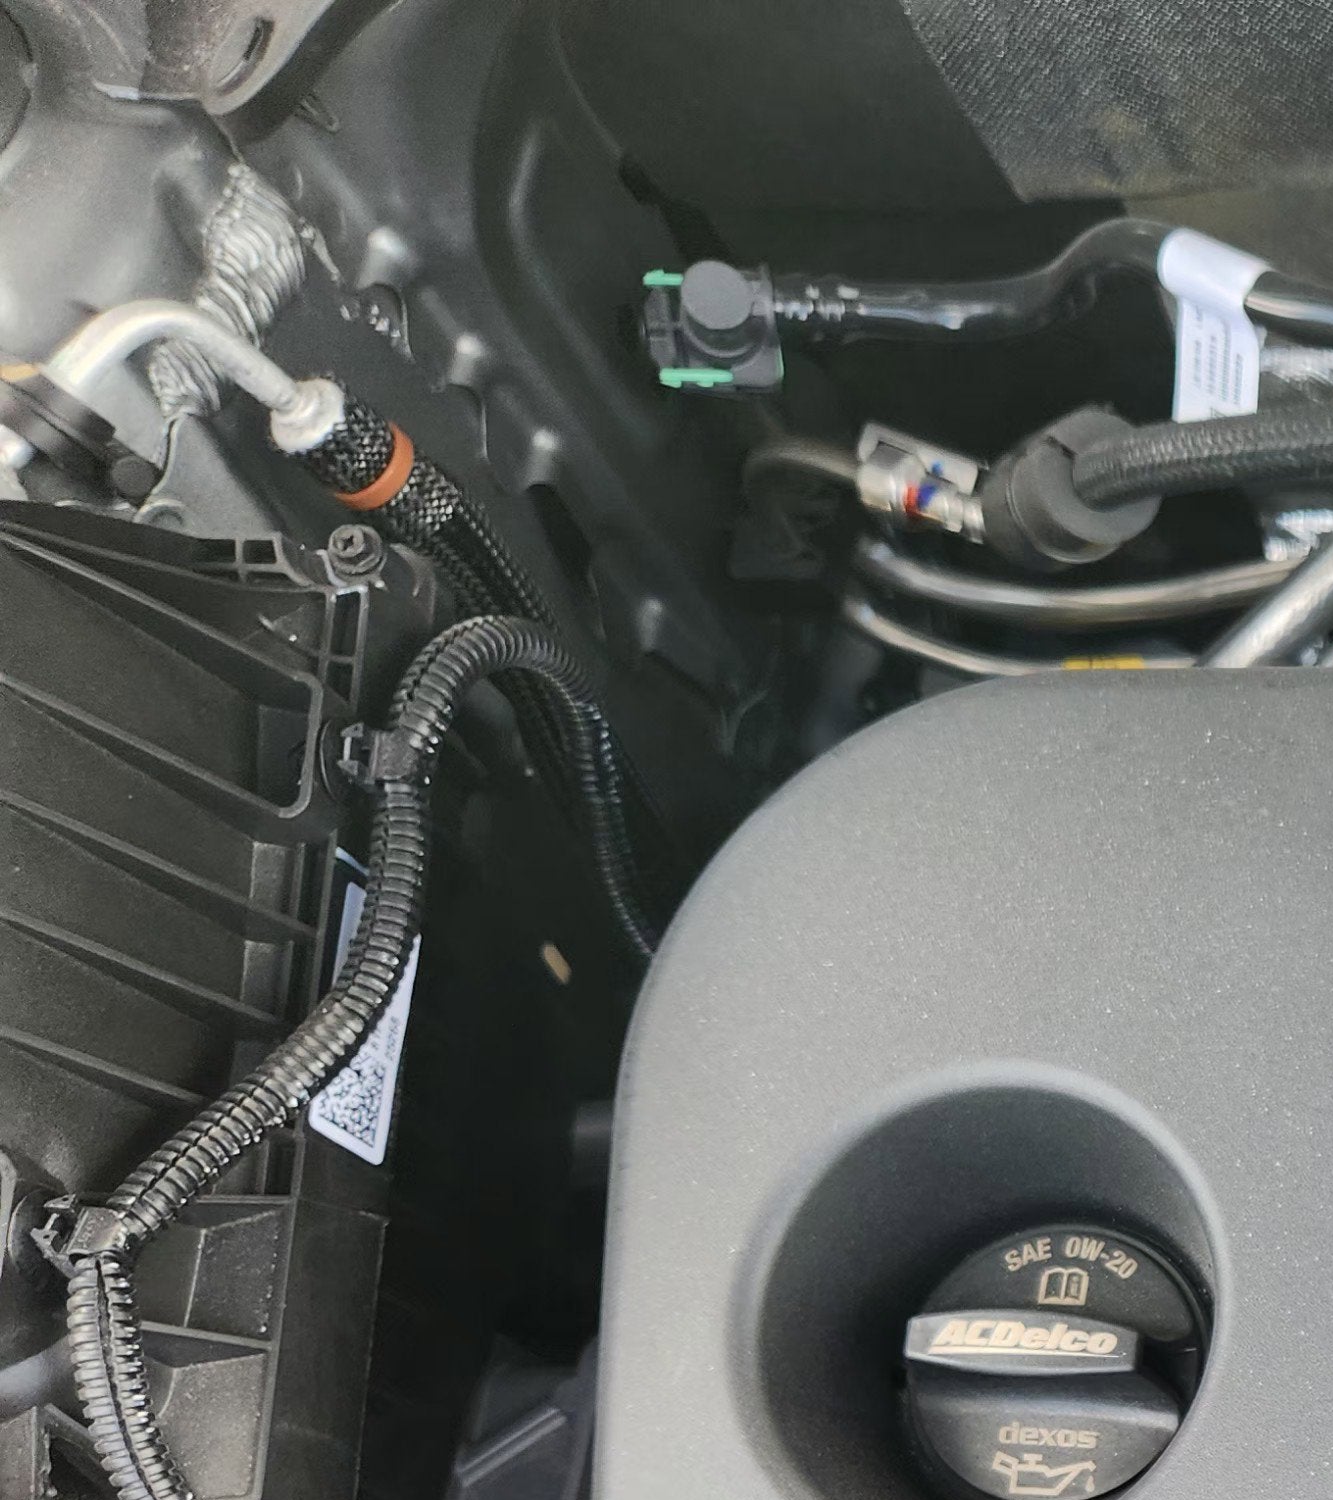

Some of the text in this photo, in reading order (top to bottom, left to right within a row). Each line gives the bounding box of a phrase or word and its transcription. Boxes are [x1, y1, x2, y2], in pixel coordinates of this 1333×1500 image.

[1004, 1236, 1138, 1279] SAE 0W-20
[930, 1318, 1118, 1355] ACDelco
[999, 1420, 1100, 1449] dexos
